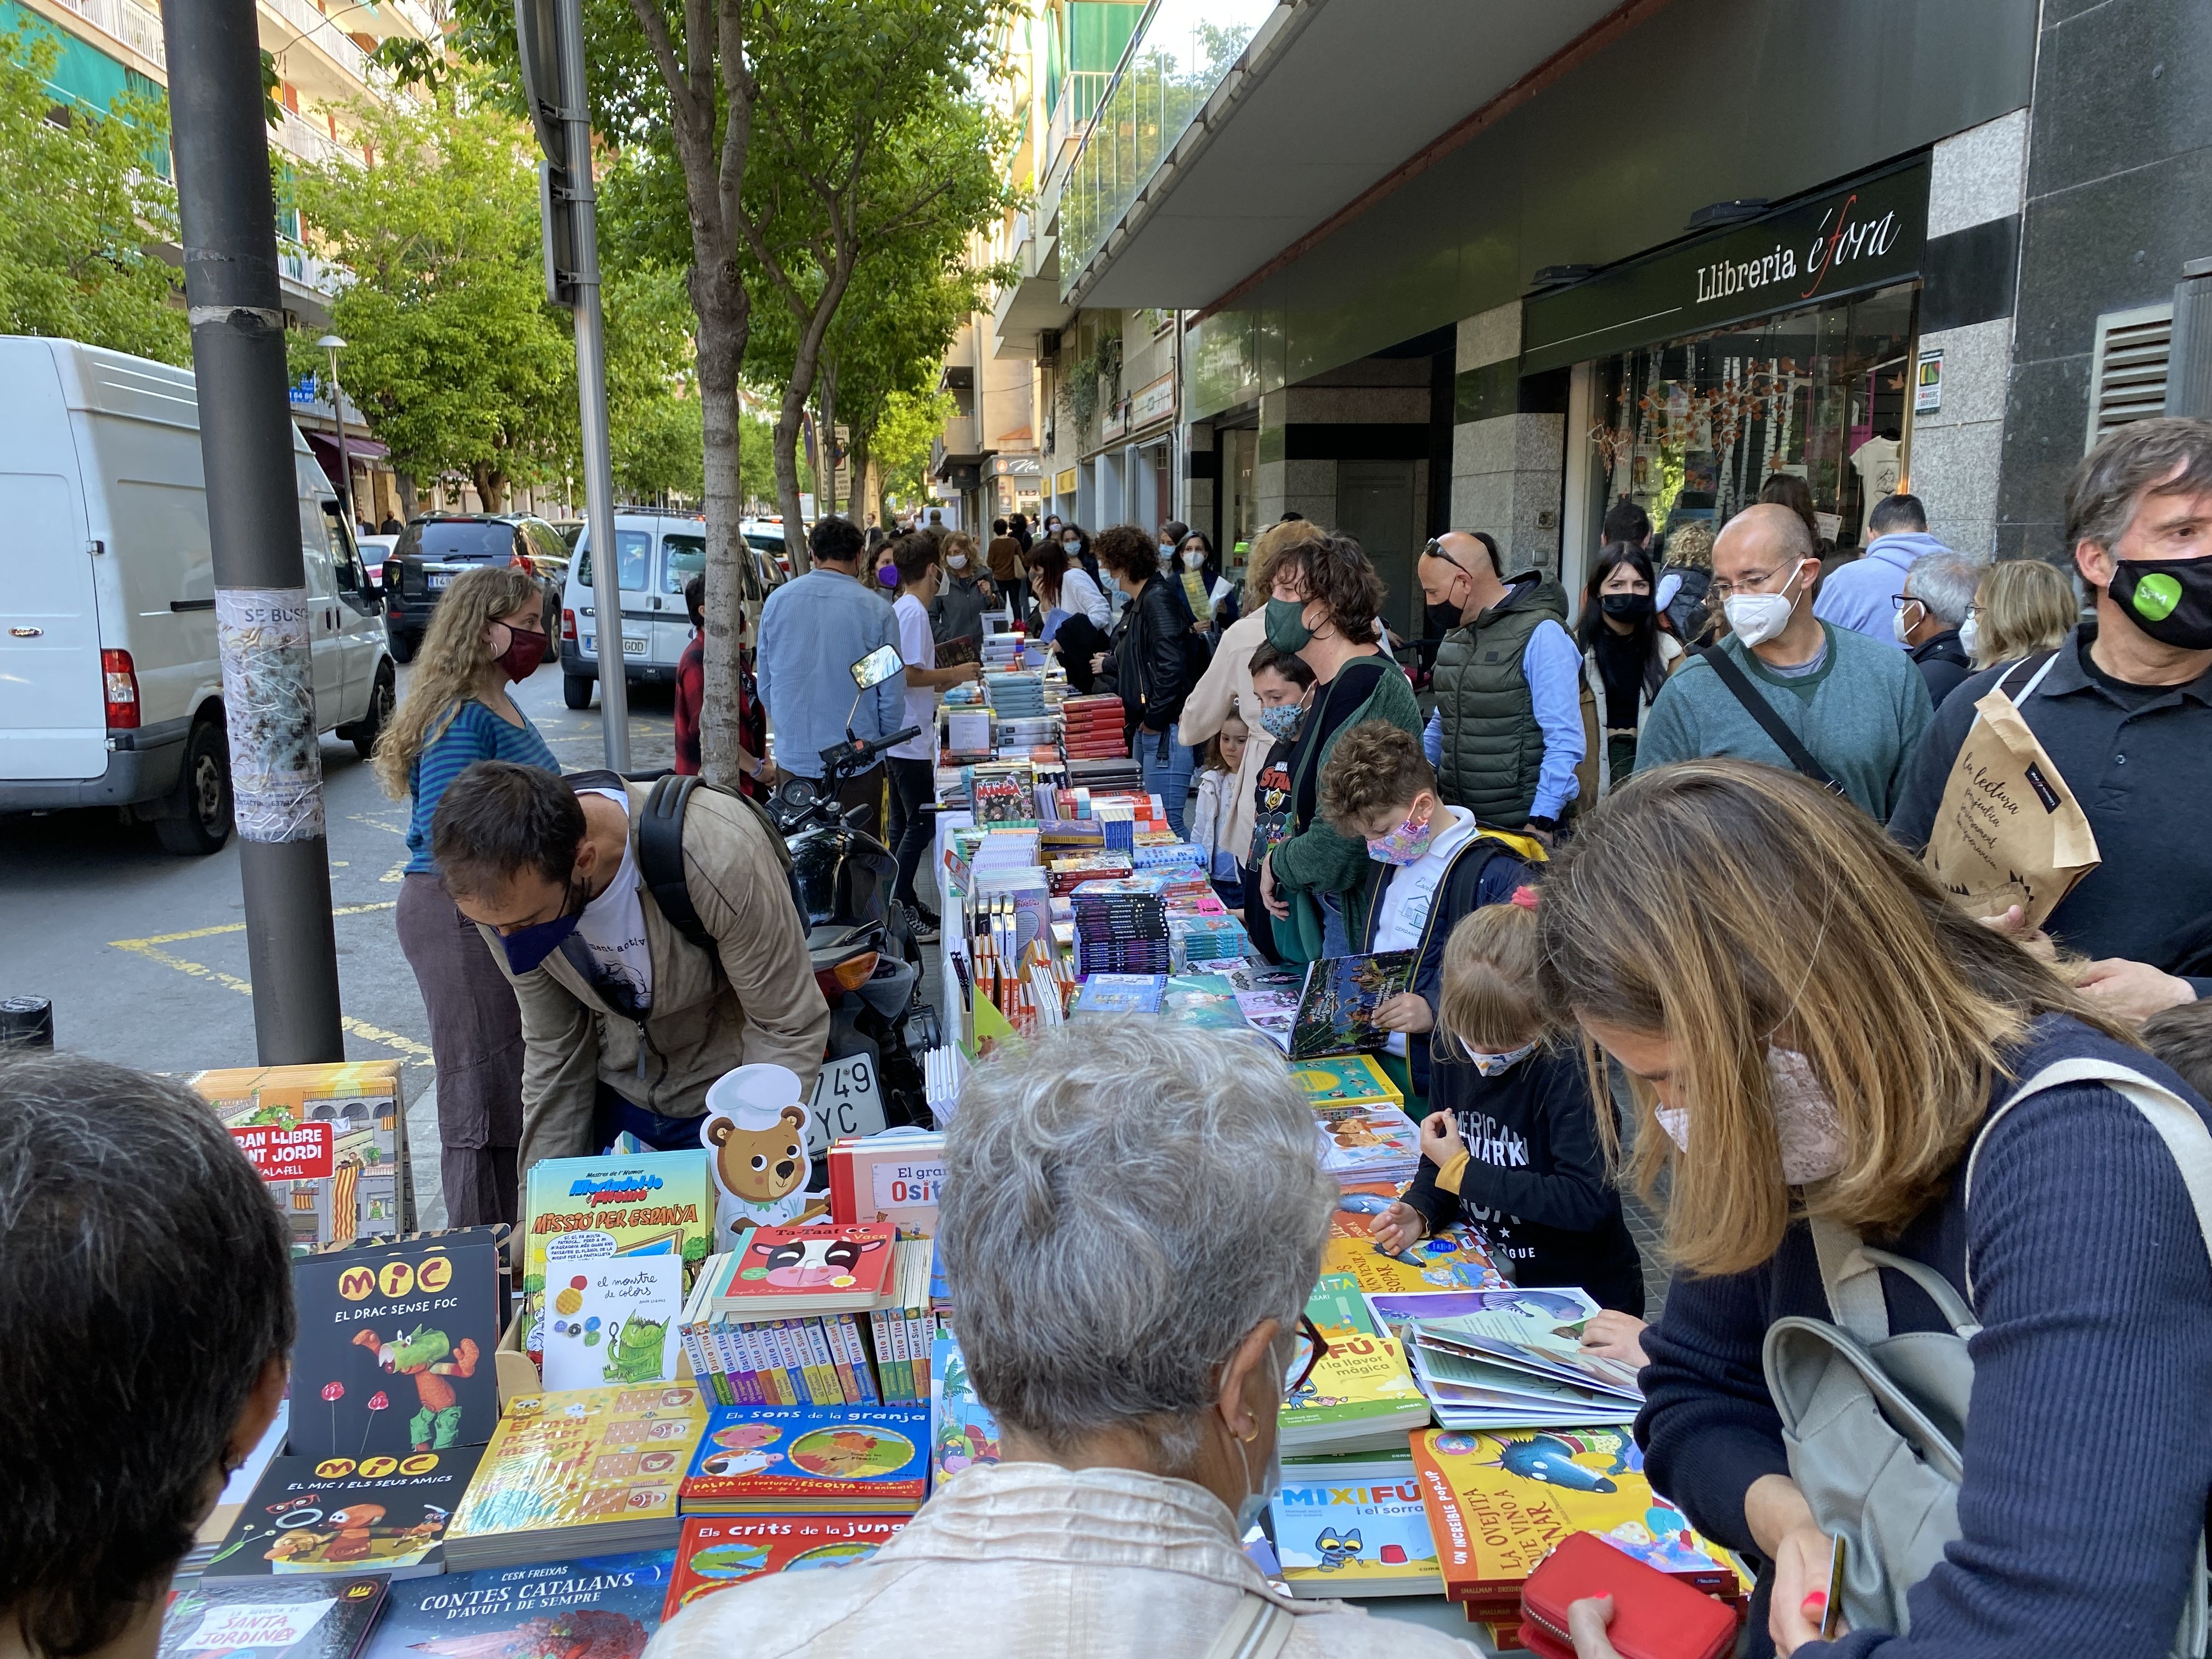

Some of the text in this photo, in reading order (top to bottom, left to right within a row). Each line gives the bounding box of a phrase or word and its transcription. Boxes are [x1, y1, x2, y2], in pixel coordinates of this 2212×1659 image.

[1697, 194, 1902, 303] Llibreria éfora
[245, 608, 266, 623] SE
[625, 641, 644, 651] GDD
[1973, 767, 2019, 815] lectura
[1383, 978, 1395, 1001] plicada
[808, 1103, 857, 1146] YC
[271, 1128, 323, 1144] LLIBRE
[272, 1144, 323, 1162] JORDI
[898, 1167, 912, 1178] El
[892, 1180, 941, 1201] Osit
[596, 1213, 627, 1229] PER
[628, 1204, 698, 1228] ESPANYA
[775, 1228, 840, 1236] Ta-Taat
[1355, 1256, 1373, 1276] VENIR
[597, 1271, 658, 1288] el monstre
[1365, 1277, 1383, 1291] VAN
[1376, 1264, 1405, 1293] SOPAR
[605, 1286, 651, 1299] de colors
[335, 1297, 458, 1323] EL DRAC SENSE FOC
[1320, 1355, 1384, 1369] i la llavor
[1336, 1363, 1390, 1378] màgica
[726, 1410, 927, 1422] Els sons de la granja
[509, 1420, 533, 1432] El
[308, 1481, 336, 1490] MIC
[346, 1480, 371, 1489] ELS
[375, 1478, 408, 1487] SEUS
[410, 1475, 453, 1485] AMICS
[693, 1481, 735, 1491] PALPA
[800, 1480, 856, 1489] ESCOLTA
[1282, 1480, 1422, 1506] MIXIFÚ
[1494, 1489, 1515, 1498] A
[1356, 1507, 1361, 1515] i
[1365, 1506, 1379, 1514] el
[1443, 1504, 1467, 1548] INCREÍBLE
[1500, 1502, 1532, 1536] VINO
[699, 1528, 720, 1538] Els
[729, 1522, 792, 1536] crits
[800, 1526, 819, 1536] de
[826, 1525, 840, 1535] la
[1463, 1488, 1522, 1570] LA OVEJITA
[1454, 1551, 1468, 1565] UN
[501, 1566, 568, 1582] CESK FREIXAS
[420, 1572, 636, 1611] CONTES CATALANS
[447, 1592, 602, 1620] D'AVUI I DE SEMPRE
[219, 1616, 289, 1629] SANTA
